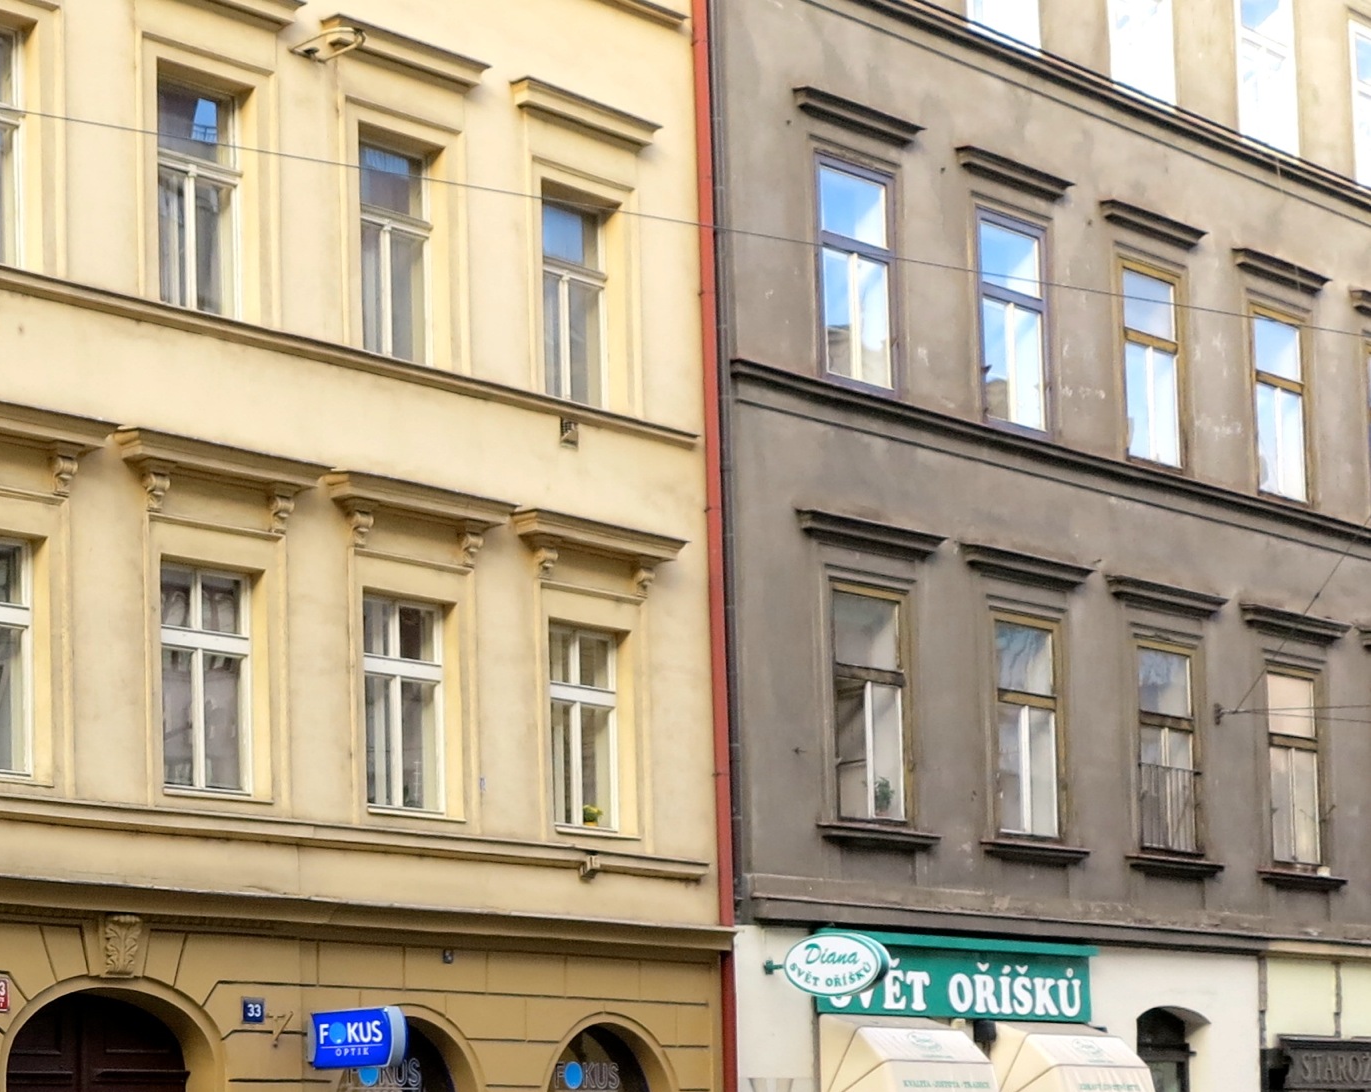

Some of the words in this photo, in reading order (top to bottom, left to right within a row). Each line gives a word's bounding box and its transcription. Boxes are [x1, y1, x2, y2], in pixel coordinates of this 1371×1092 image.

[804, 943, 861, 964] Diana
[790, 962, 820, 987] SVĚT
[825, 961, 872, 987] OŘÍŠKŮ
[948, 961, 1082, 1017] OŘÍŠKŮ
[247, 1003, 262, 1018] 33
[319, 1020, 383, 1045] FOKUS
[335, 1047, 370, 1057] OPTIK
[554, 1061, 620, 1090] FOKUS
